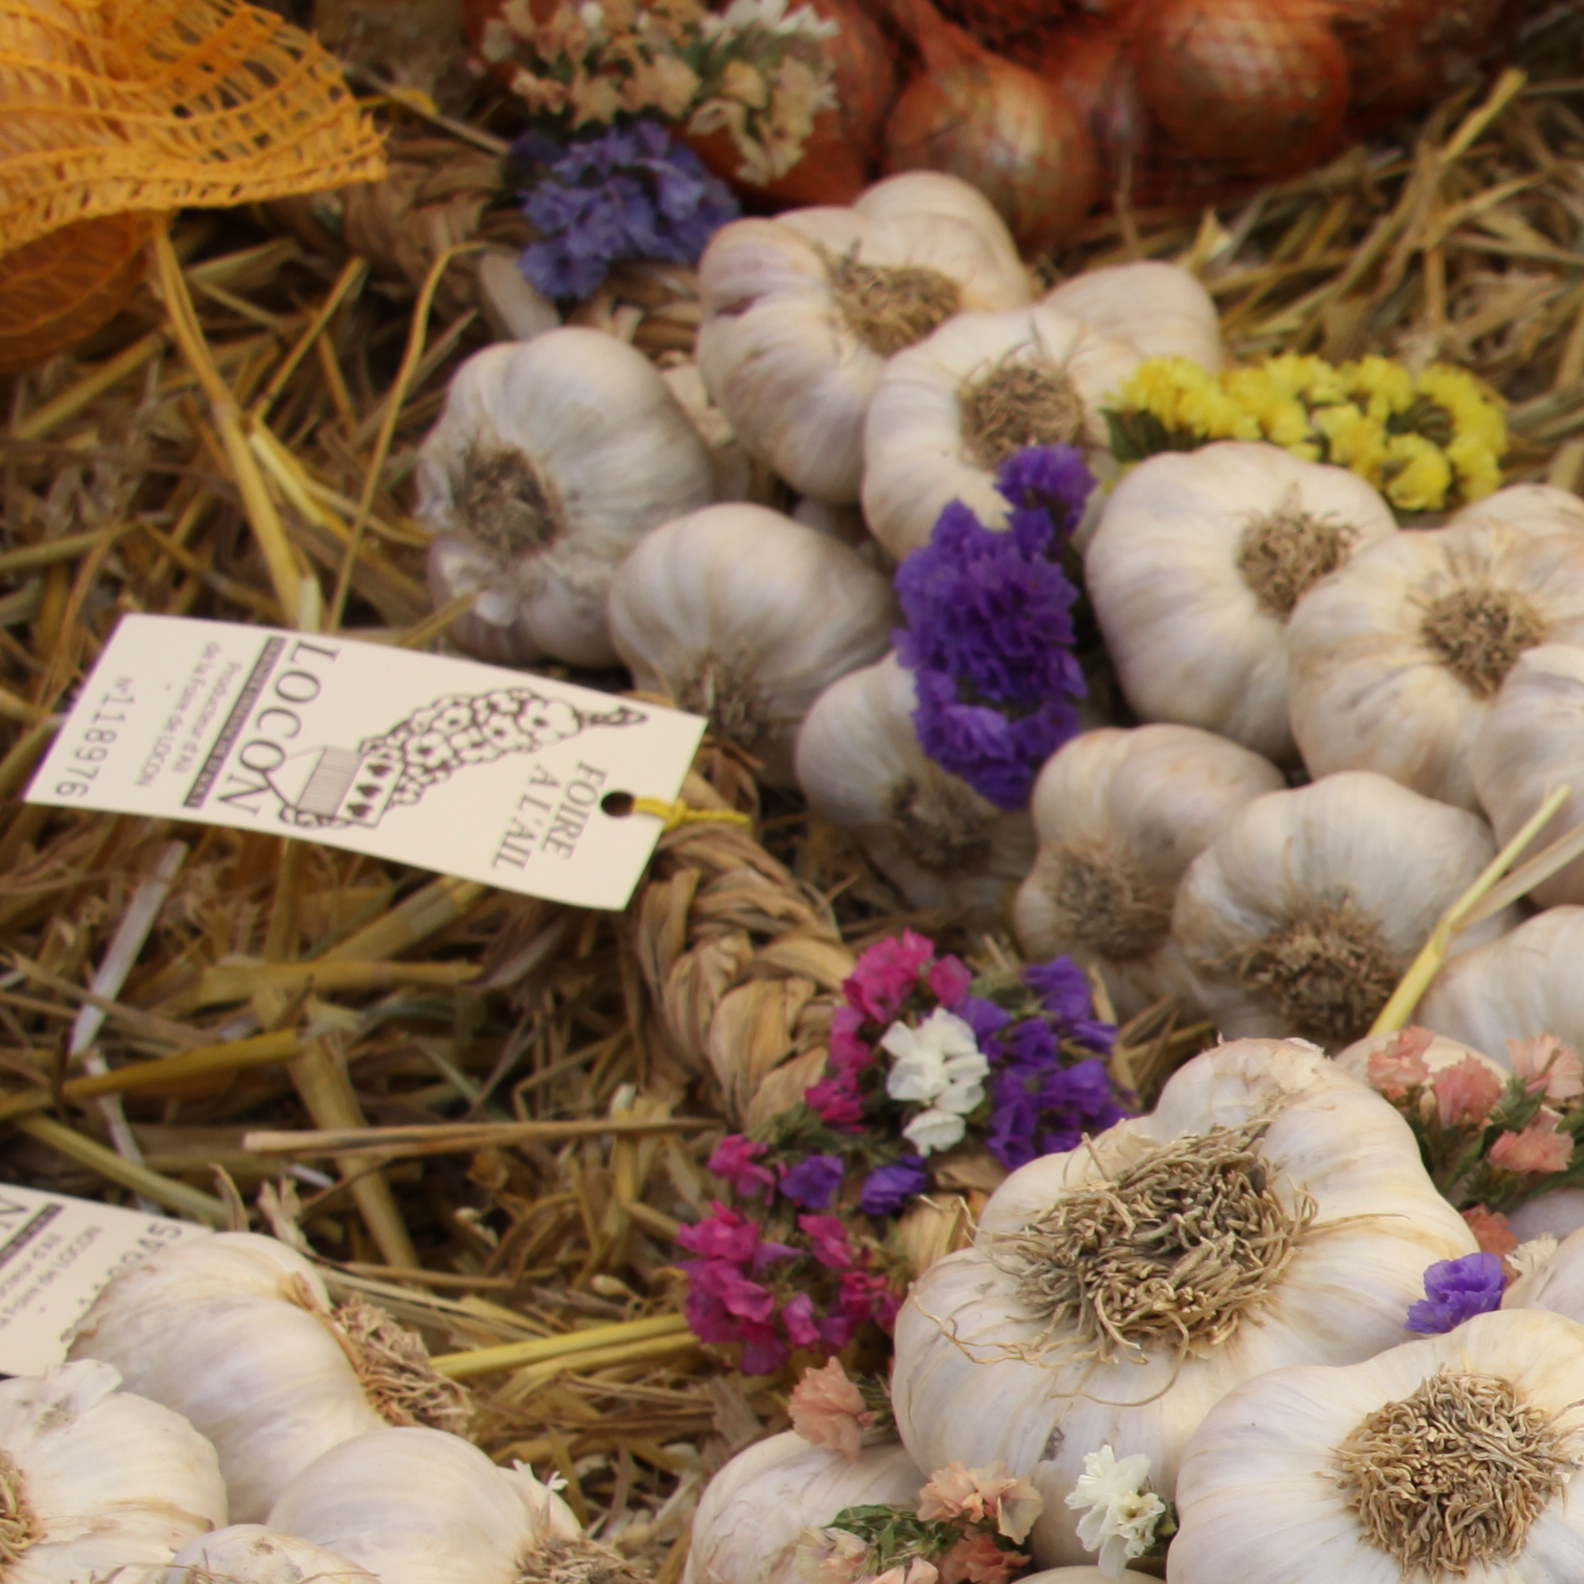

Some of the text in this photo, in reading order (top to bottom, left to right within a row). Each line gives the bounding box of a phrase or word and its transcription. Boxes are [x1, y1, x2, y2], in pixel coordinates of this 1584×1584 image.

[217, 641, 341, 816] LOCON
[492, 763, 561, 870] A L'AIL
[541, 760, 608, 860] FOIRE
